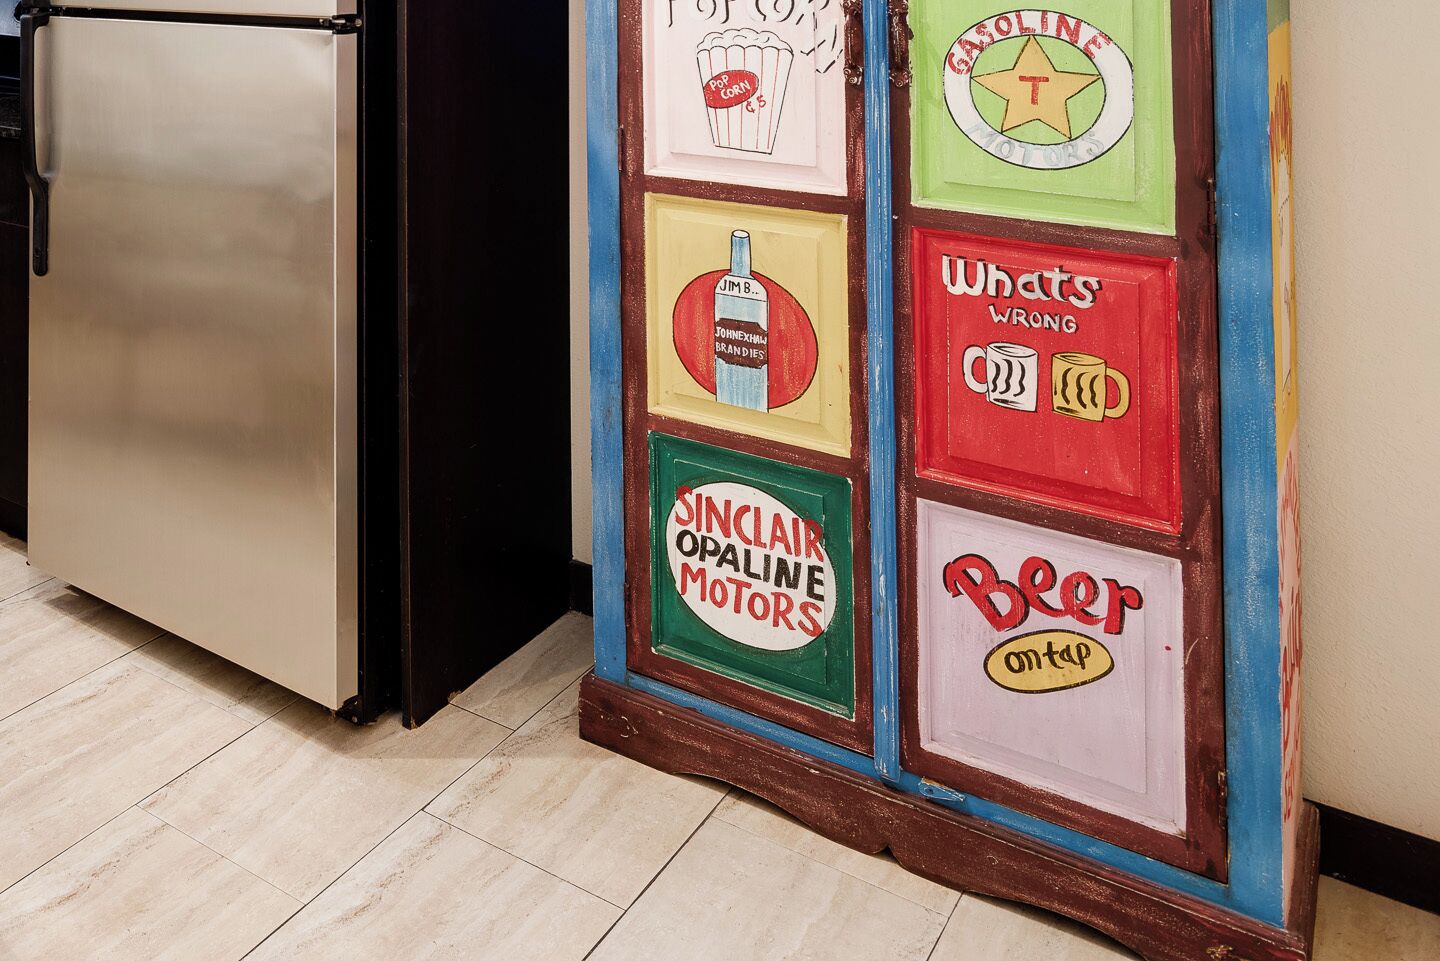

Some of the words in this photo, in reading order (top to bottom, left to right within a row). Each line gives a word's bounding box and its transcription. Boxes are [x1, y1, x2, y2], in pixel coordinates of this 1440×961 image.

[947, 10, 1114, 76] GASOLINE
[708, 74, 729, 91] POP
[720, 80, 751, 100] CORN
[1018, 75, 1050, 105] T
[964, 120, 1105, 167] MOTORS
[719, 279, 741, 294] JIM
[988, 304, 1079, 334] WRONG
[715, 342, 765, 360] BRANDIES
[675, 486, 824, 562] SINCLAIR
[675, 529, 825, 602] OPALINE
[680, 562, 825, 638] MOTORS
[943, 553, 1144, 635] Beer
